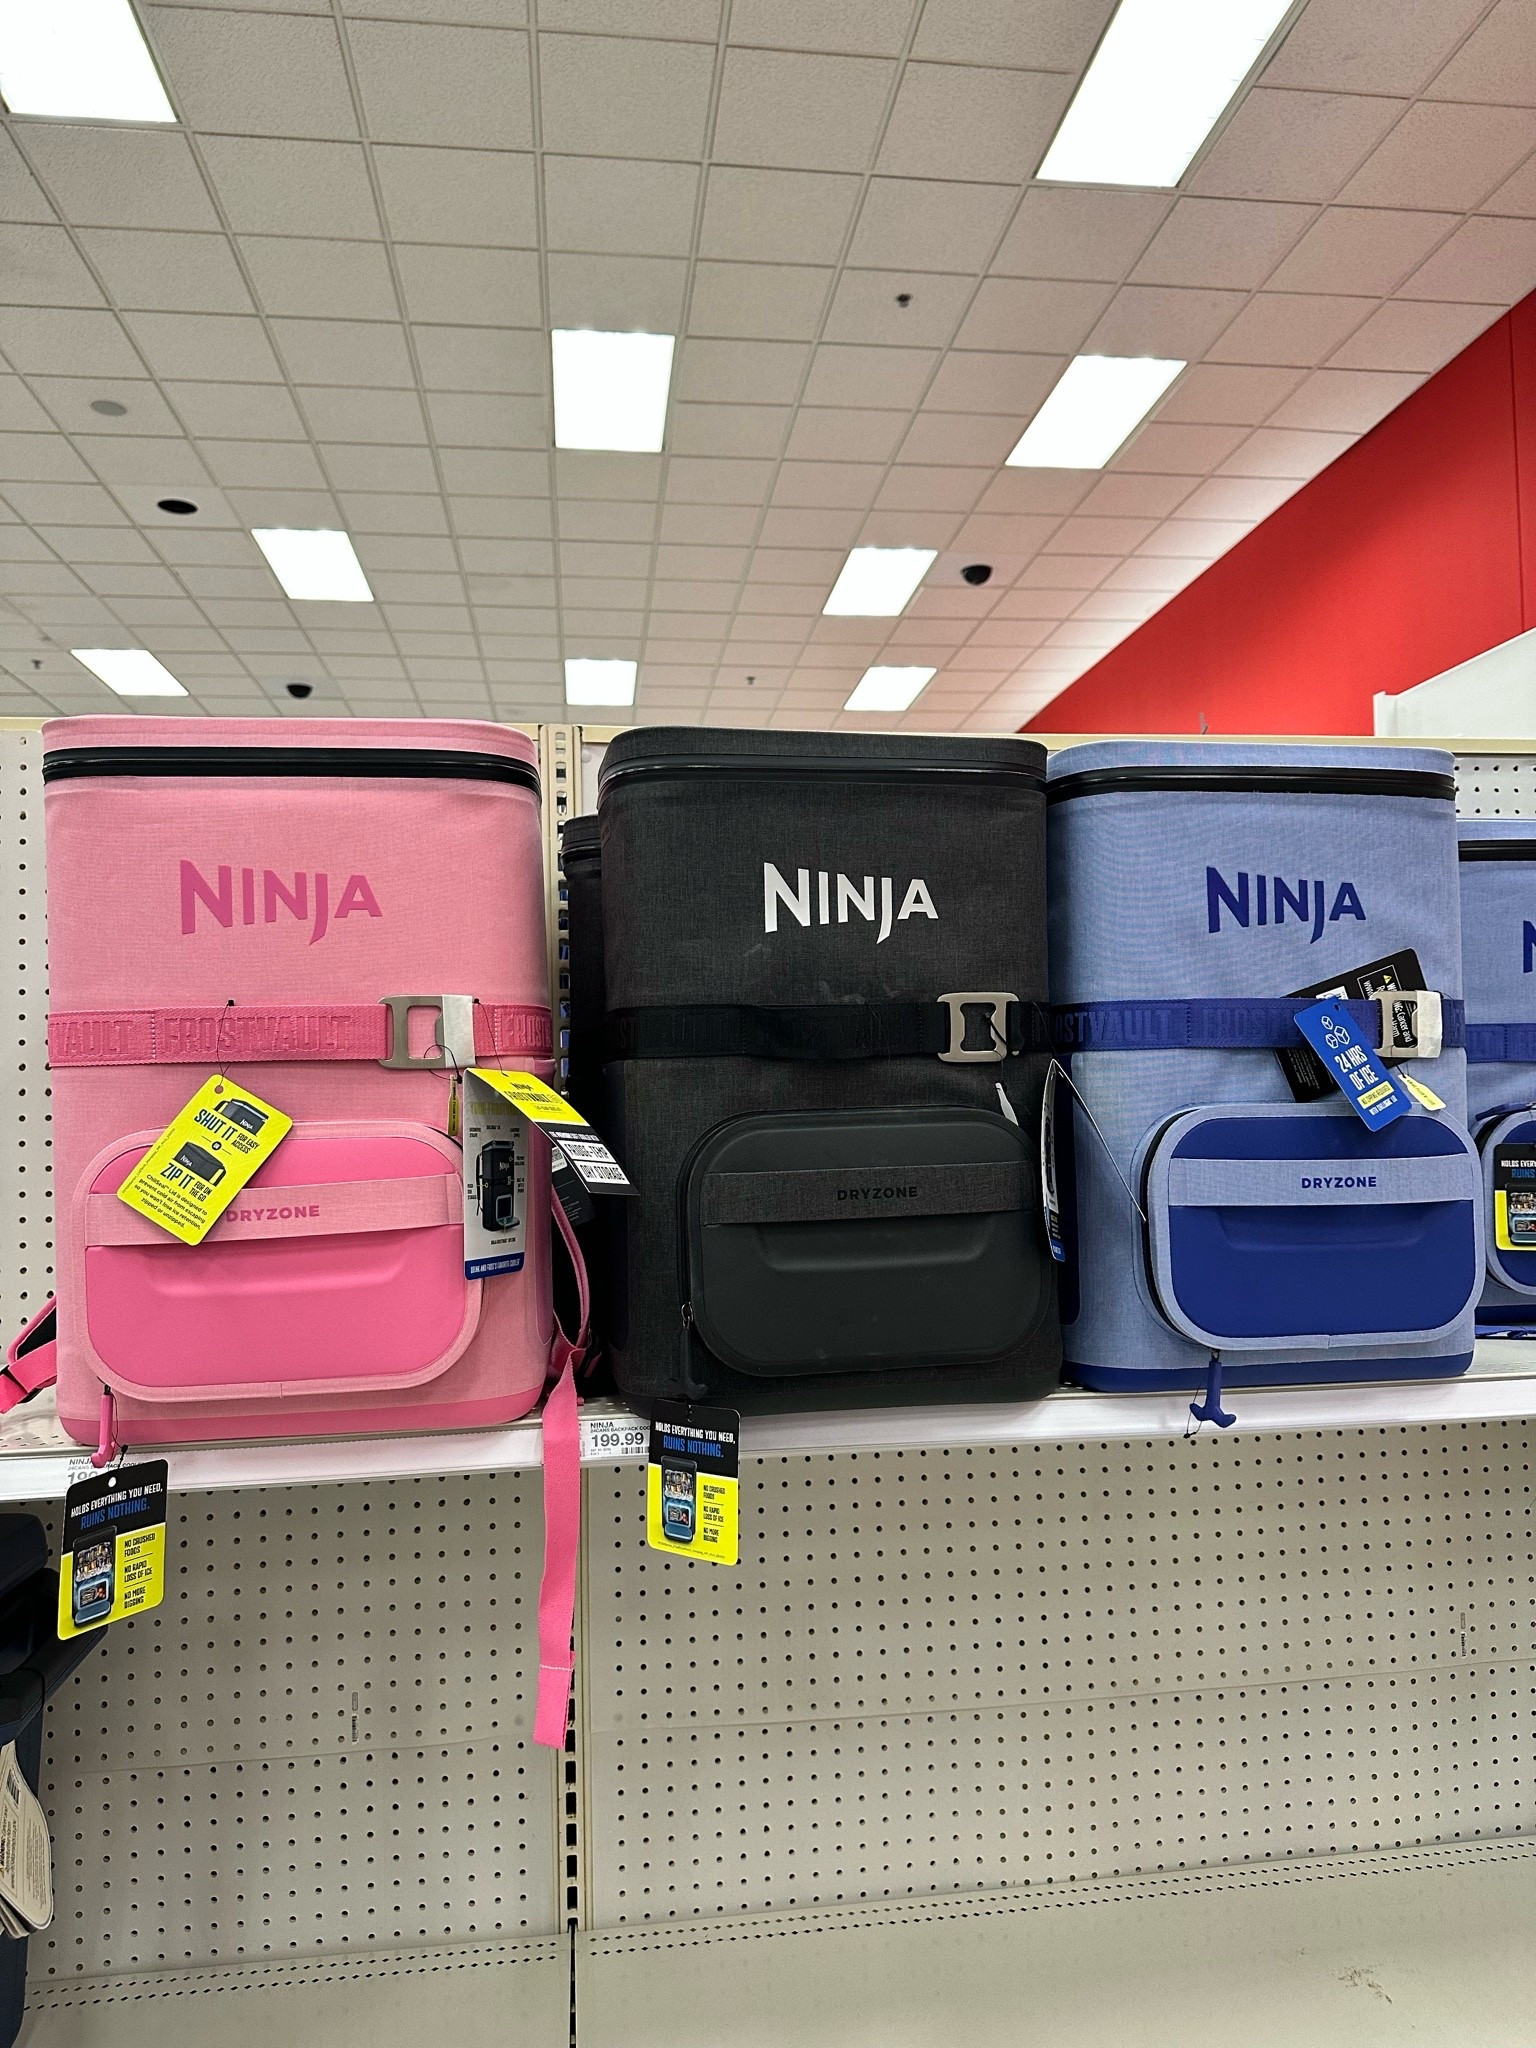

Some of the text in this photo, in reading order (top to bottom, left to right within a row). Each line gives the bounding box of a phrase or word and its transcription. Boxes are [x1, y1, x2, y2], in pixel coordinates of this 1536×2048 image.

[180, 860, 383, 946] NINJA
[764, 862, 939, 944] NINJA
[1206, 866, 1367, 944] NINJA
[1396, 1011, 1409, 1031] Cancer
[163, 1016, 352, 1053] FROSTVAULT
[1334, 1052, 1352, 1073] 24
[1345, 1044, 1368, 1067] HRS
[1348, 1064, 1379, 1091] OF ICE
[194, 1108, 238, 1141] SHUT IT
[231, 1139, 252, 1155] ACCESS
[236, 1132, 260, 1150] FOR EASY
[1501, 1159, 1519, 1168] HOLDS
[160, 1162, 195, 1190] ZIP IT
[580, 1164, 625, 1181] DRY STORAGE
[1511, 1168, 1536, 1179] RUINS
[193, 1180, 213, 1196] FOR ON
[1301, 1176, 1377, 1189] DRYZONE
[139, 1188, 150, 1197] you
[162, 1202, 173, 1211] lose
[139, 1178, 158, 1193] prevent
[156, 1189, 168, 1199] cold
[173, 1199, 186, 1211] from
[184, 1208, 206, 1225] escaping
[168, 1188, 178, 1197] Lid
[180, 1195, 202, 1213] designed
[189, 1187, 207, 1203] THE GO
[837, 1186, 918, 1201] DRYZONE
[141, 1197, 158, 1210] zipped
[226, 1205, 320, 1222] DRYZONE
[591, 1421, 614, 1429] NINJA
[655, 1421, 736, 1445] HOLDS EVERYTHING YOU NEED,
[591, 1431, 645, 1448] 199.99
[663, 1435, 724, 1458] RUINS NOTHING.
[703, 1484, 726, 1495] NO CRUSHED
[70, 1482, 163, 1519] HOLDS EVERYTHING YOU NEED,
[80, 1497, 150, 1531] RUINS NOTHING.
[703, 1505, 720, 1515] NO RAPID
[703, 1513, 713, 1521] LOSS
[703, 1526, 720, 1537] NO MORE
[124, 1532, 156, 1549] NO CRUSHED
[124, 1545, 141, 1558] FOODS
[124, 1560, 147, 1574] NO RAPID
[124, 1566, 153, 1583] LOSS OF ICE
[124, 1585, 146, 1601] NO MORE
